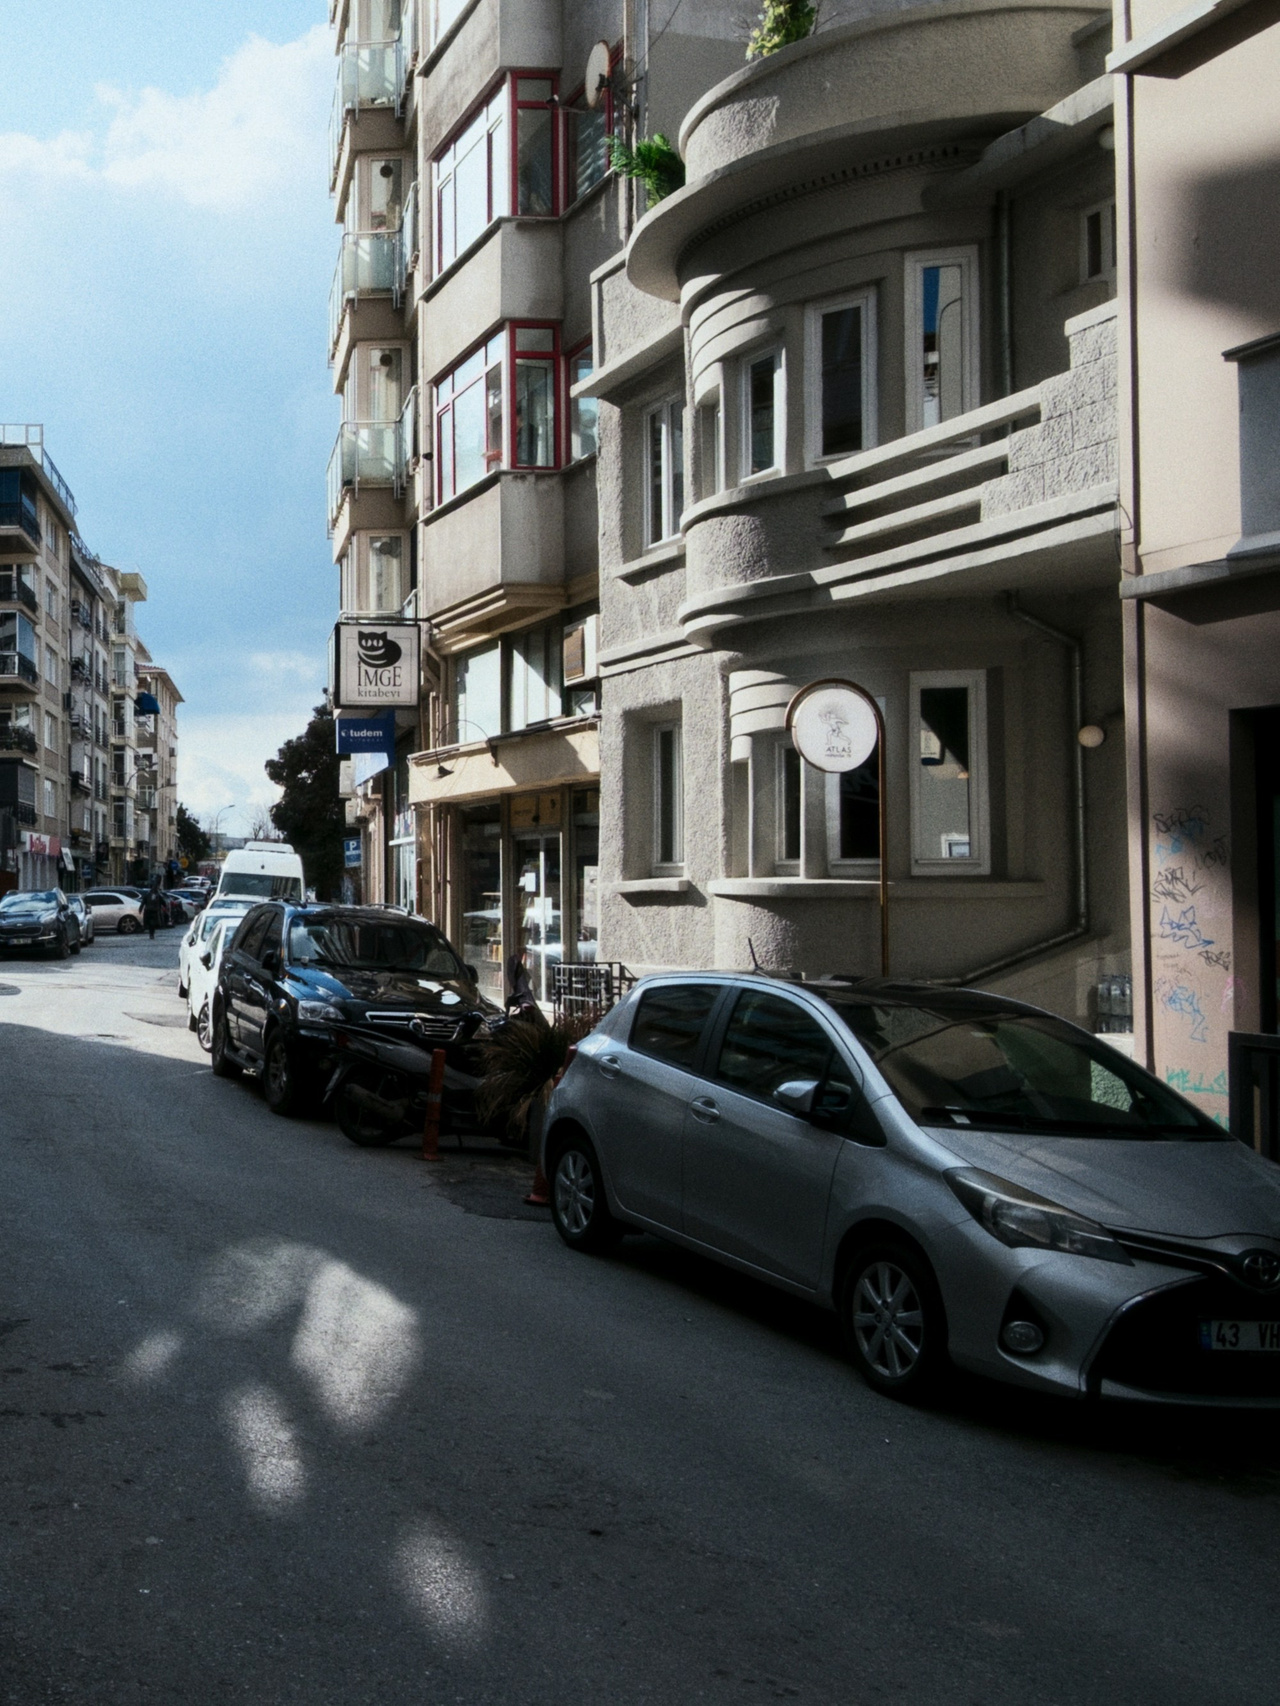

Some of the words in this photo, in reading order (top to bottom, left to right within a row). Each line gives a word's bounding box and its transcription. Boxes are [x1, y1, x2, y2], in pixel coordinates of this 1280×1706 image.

[357, 687, 401, 698] kitabevi
[349, 729, 383, 738] tudem
[1216, 1323, 1240, 1348] 43
